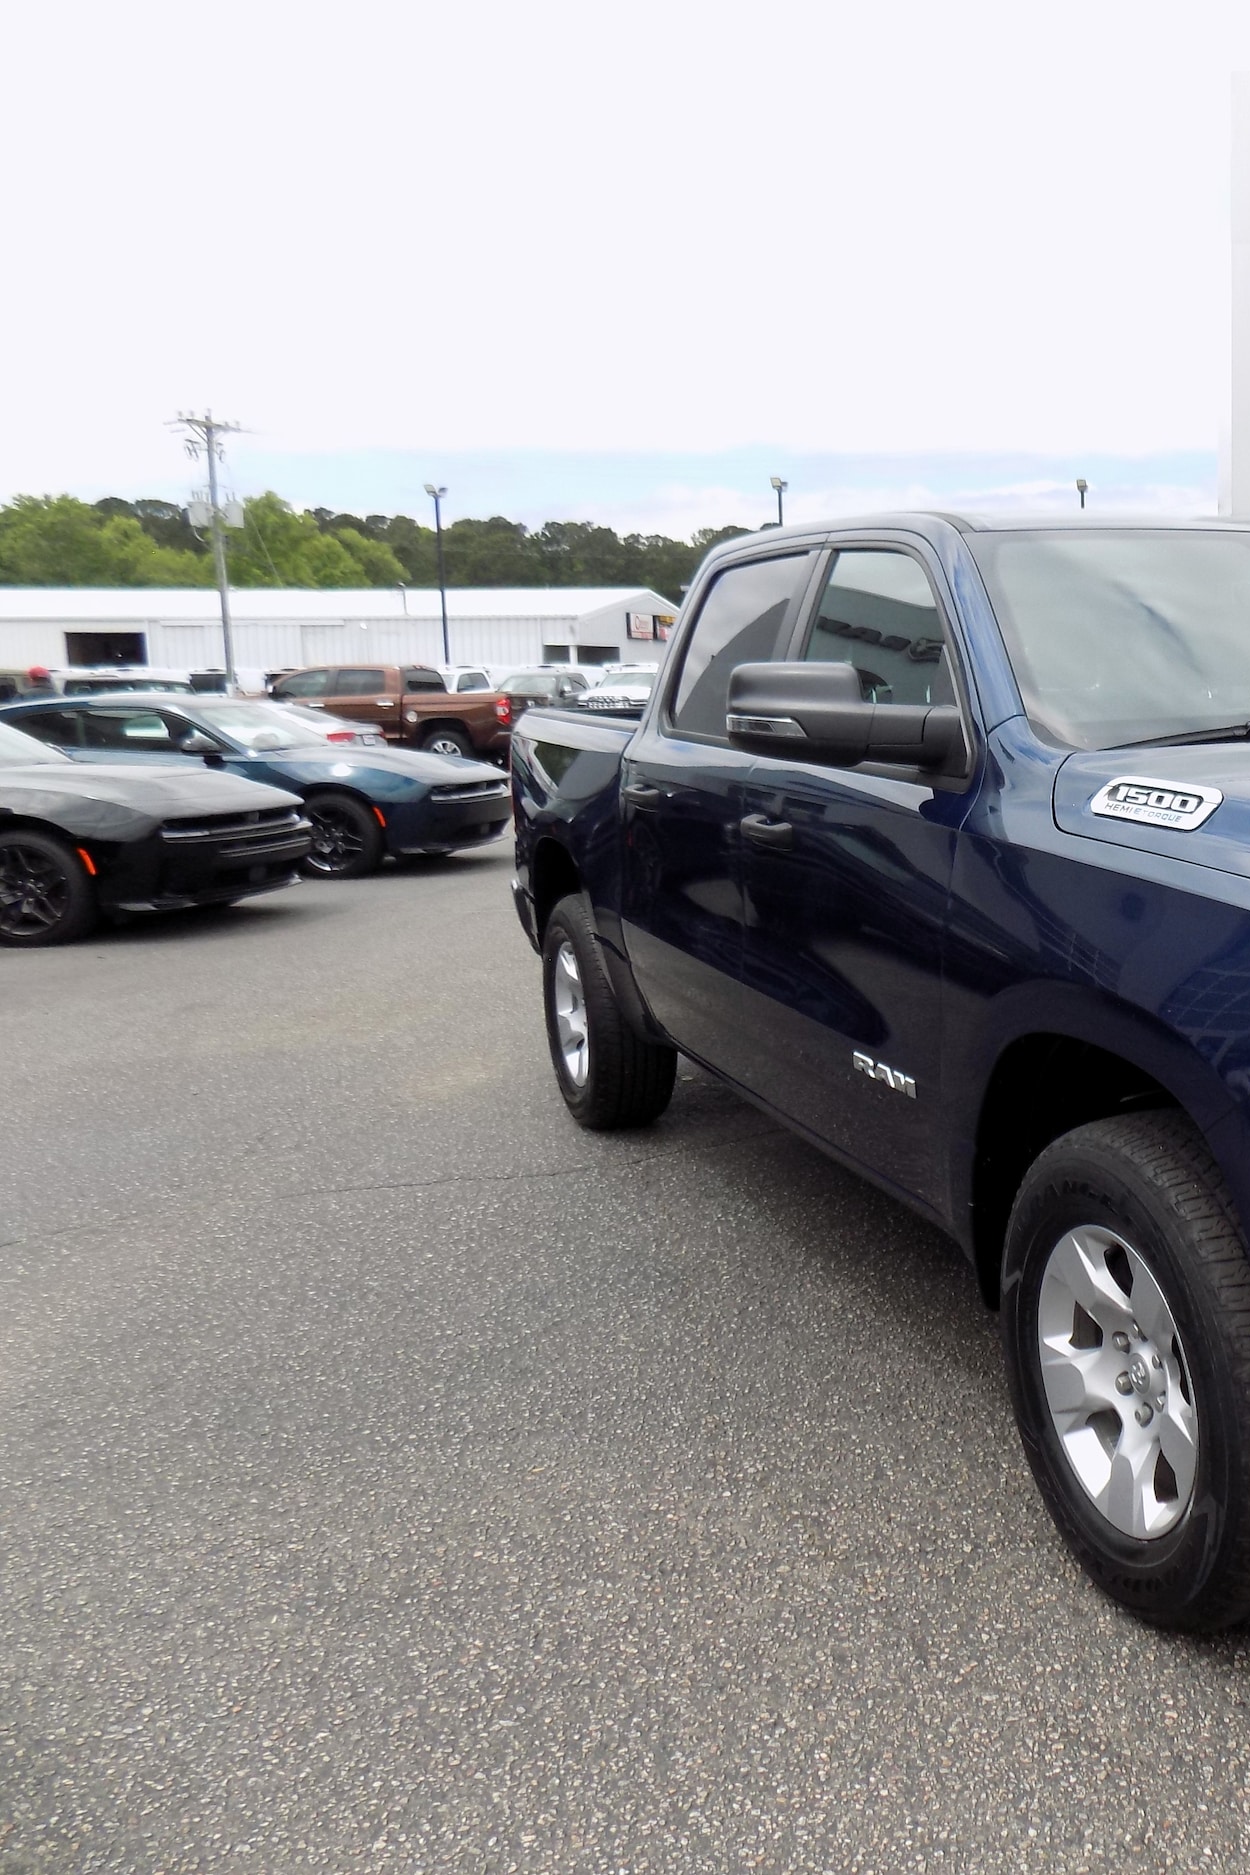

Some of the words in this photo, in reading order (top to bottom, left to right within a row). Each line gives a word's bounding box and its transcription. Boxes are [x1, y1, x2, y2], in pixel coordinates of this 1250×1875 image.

[1104, 802, 1132, 815] HEMI
[1115, 786, 1199, 814] 1500
[852, 1051, 917, 1099] RAM
